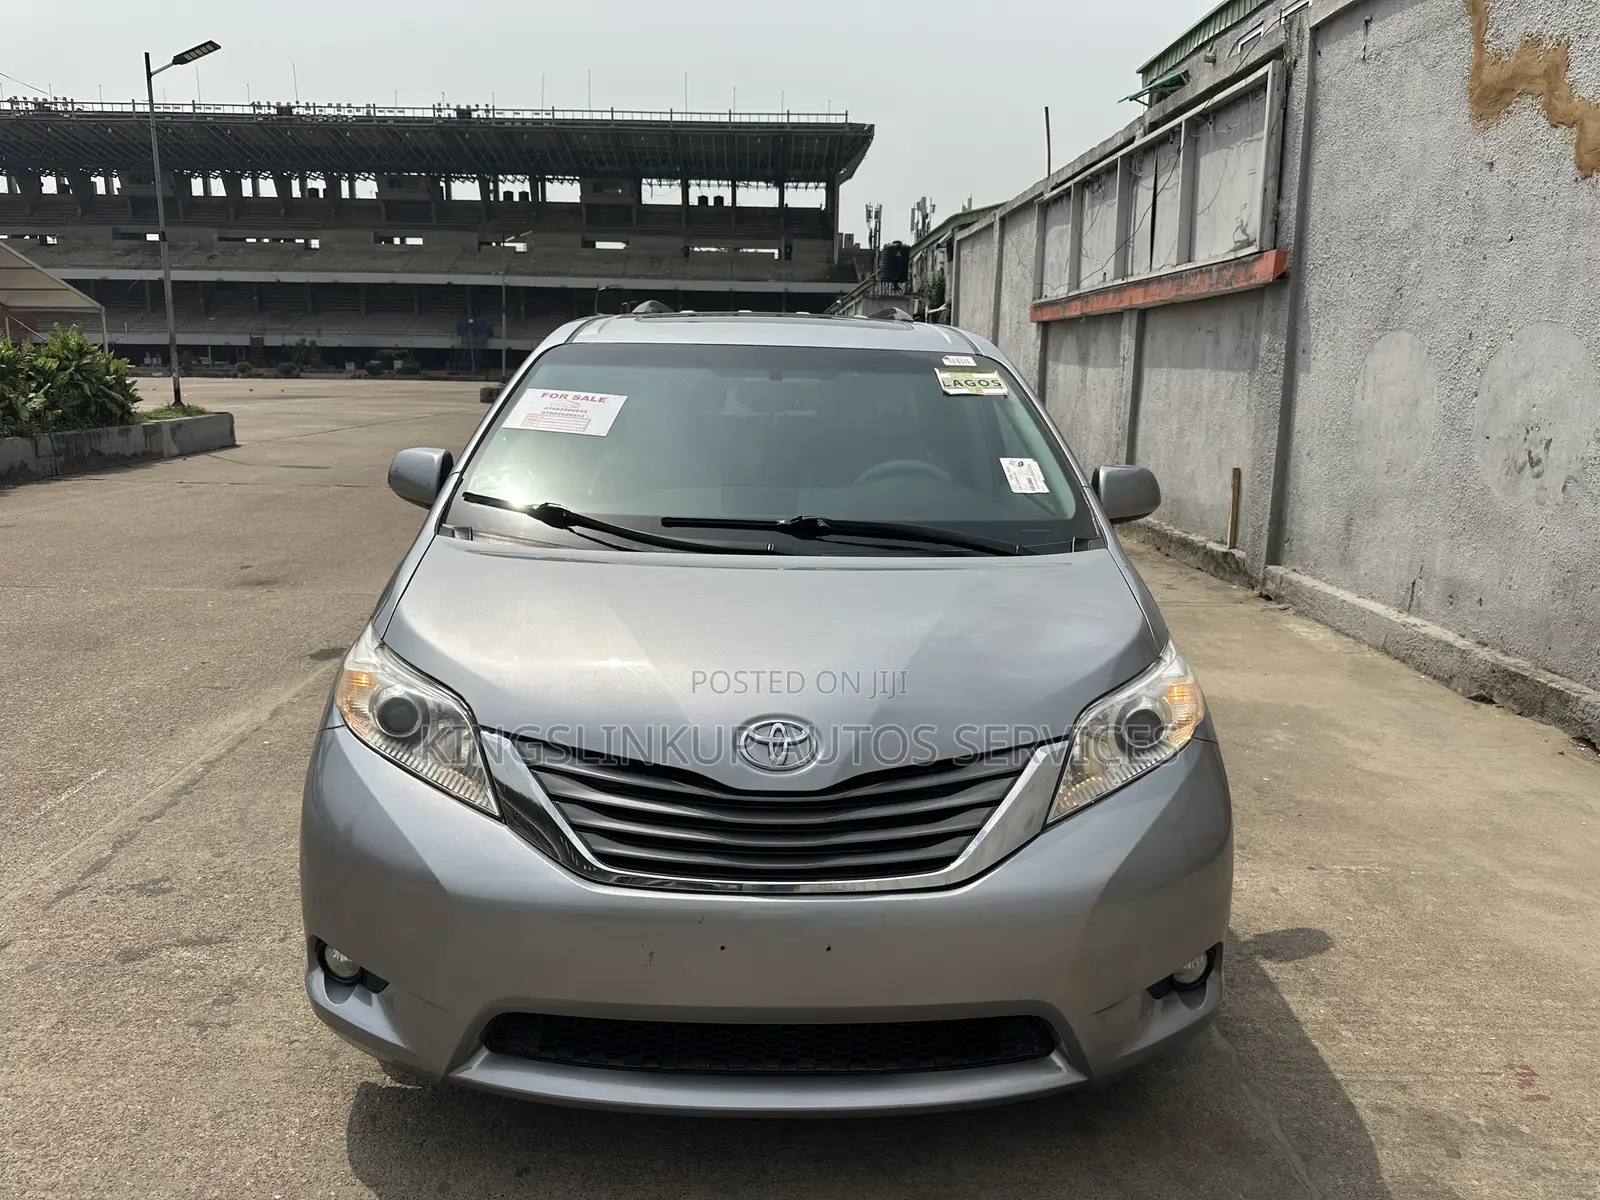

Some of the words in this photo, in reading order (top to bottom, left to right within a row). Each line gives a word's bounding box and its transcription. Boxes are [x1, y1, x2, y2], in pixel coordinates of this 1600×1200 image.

[942, 379, 1002, 388] LAGOS
[541, 392, 569, 401] FOR
[572, 394, 608, 404] SALE
